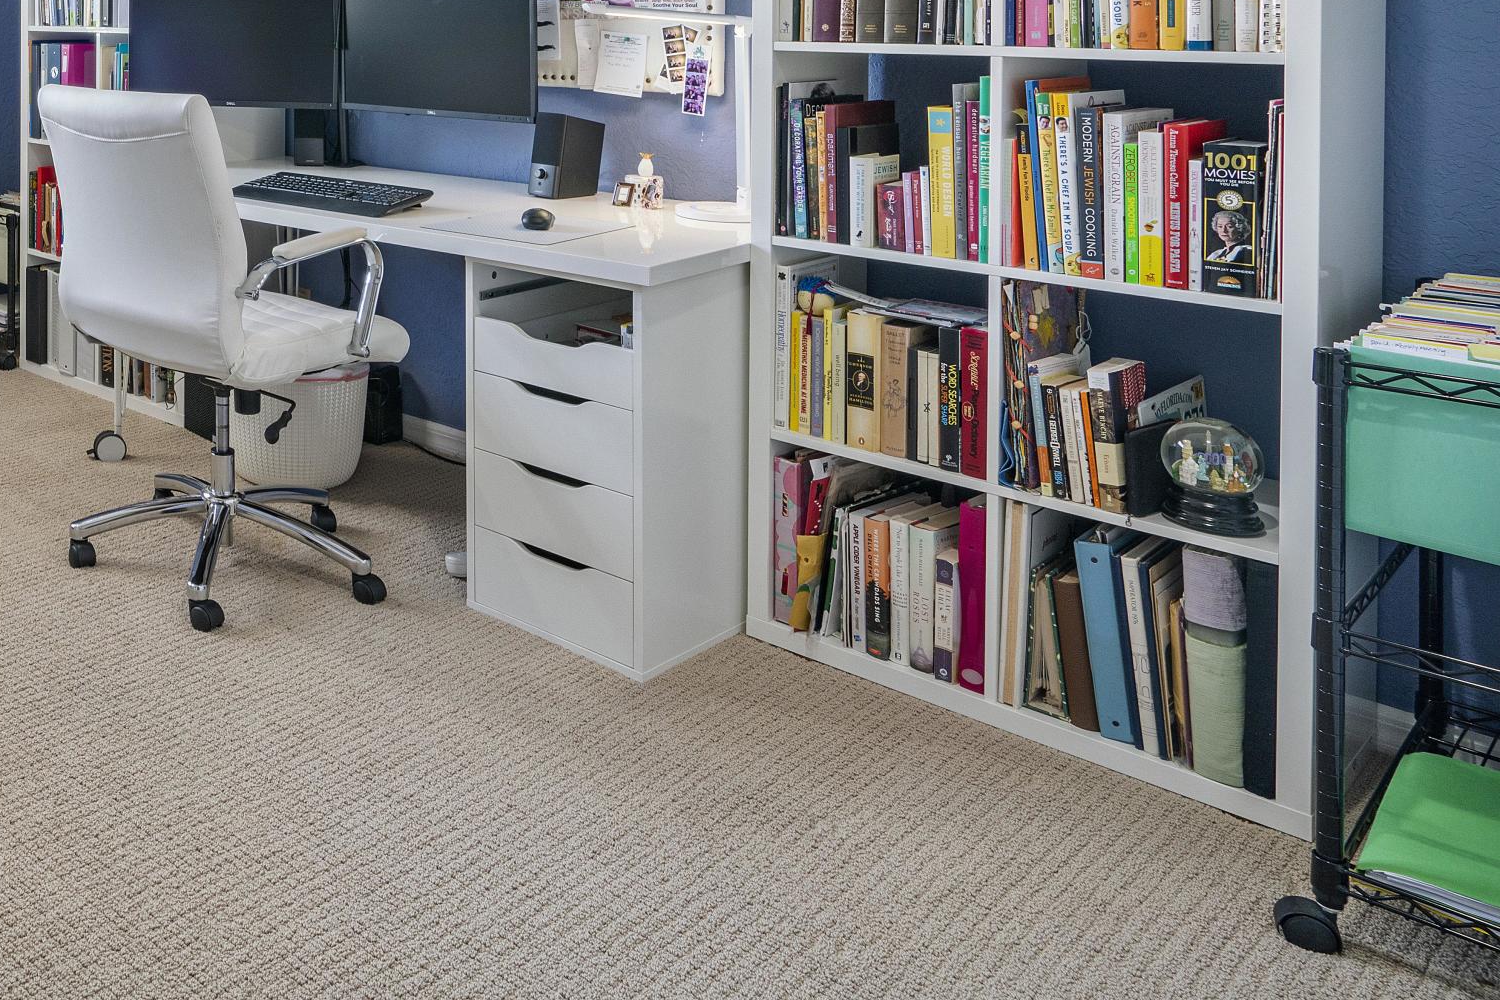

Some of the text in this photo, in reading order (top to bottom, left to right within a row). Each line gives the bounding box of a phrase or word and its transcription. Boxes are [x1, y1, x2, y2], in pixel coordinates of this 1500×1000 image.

[1113, 0, 1122, 26] SOUP!
[794, 122, 803, 165] DECORATING
[1059, 135, 1068, 166] THERE'S
[1169, 128, 1179, 148] Anna
[827, 133, 835, 176] apartment
[980, 140, 990, 189] VEGETARIAN
[1110, 124, 1121, 204] AGAINST GRAIN
[1204, 152, 1257, 171] 1001
[796, 166, 804, 184] YOUR
[874, 164, 898, 175] JEWISH
[942, 146, 952, 217] WORLD DESIGN
[1204, 168, 1256, 180] MOVIES
[1062, 179, 1070, 198] CHEF
[1082, 117, 1096, 257] MODERN JEWISH COOKING
[1063, 202, 1071, 210] IN
[1063, 214, 1071, 226] MY
[1126, 197, 1136, 238] SMOOTHIES
[1064, 229, 1073, 254] SOUP!
[1110, 208, 1118, 261] Danielle Walker
[1170, 202, 1181, 273] MENUS FOR PASTA
[777, 311, 787, 352] Homeopathy
[800, 365, 808, 391] MEDICINE
[940, 385, 948, 403] SUPER
[948, 364, 957, 426] WORD SEARCHES
[940, 405, 948, 425] SHARP
[1096, 391, 1107, 440] MAEVE BINCHY
[1049, 420, 1061, 467] GEORGE ORWELL
[1054, 471, 1063, 485] 1984
[853, 567, 861, 595] VINEGAR
